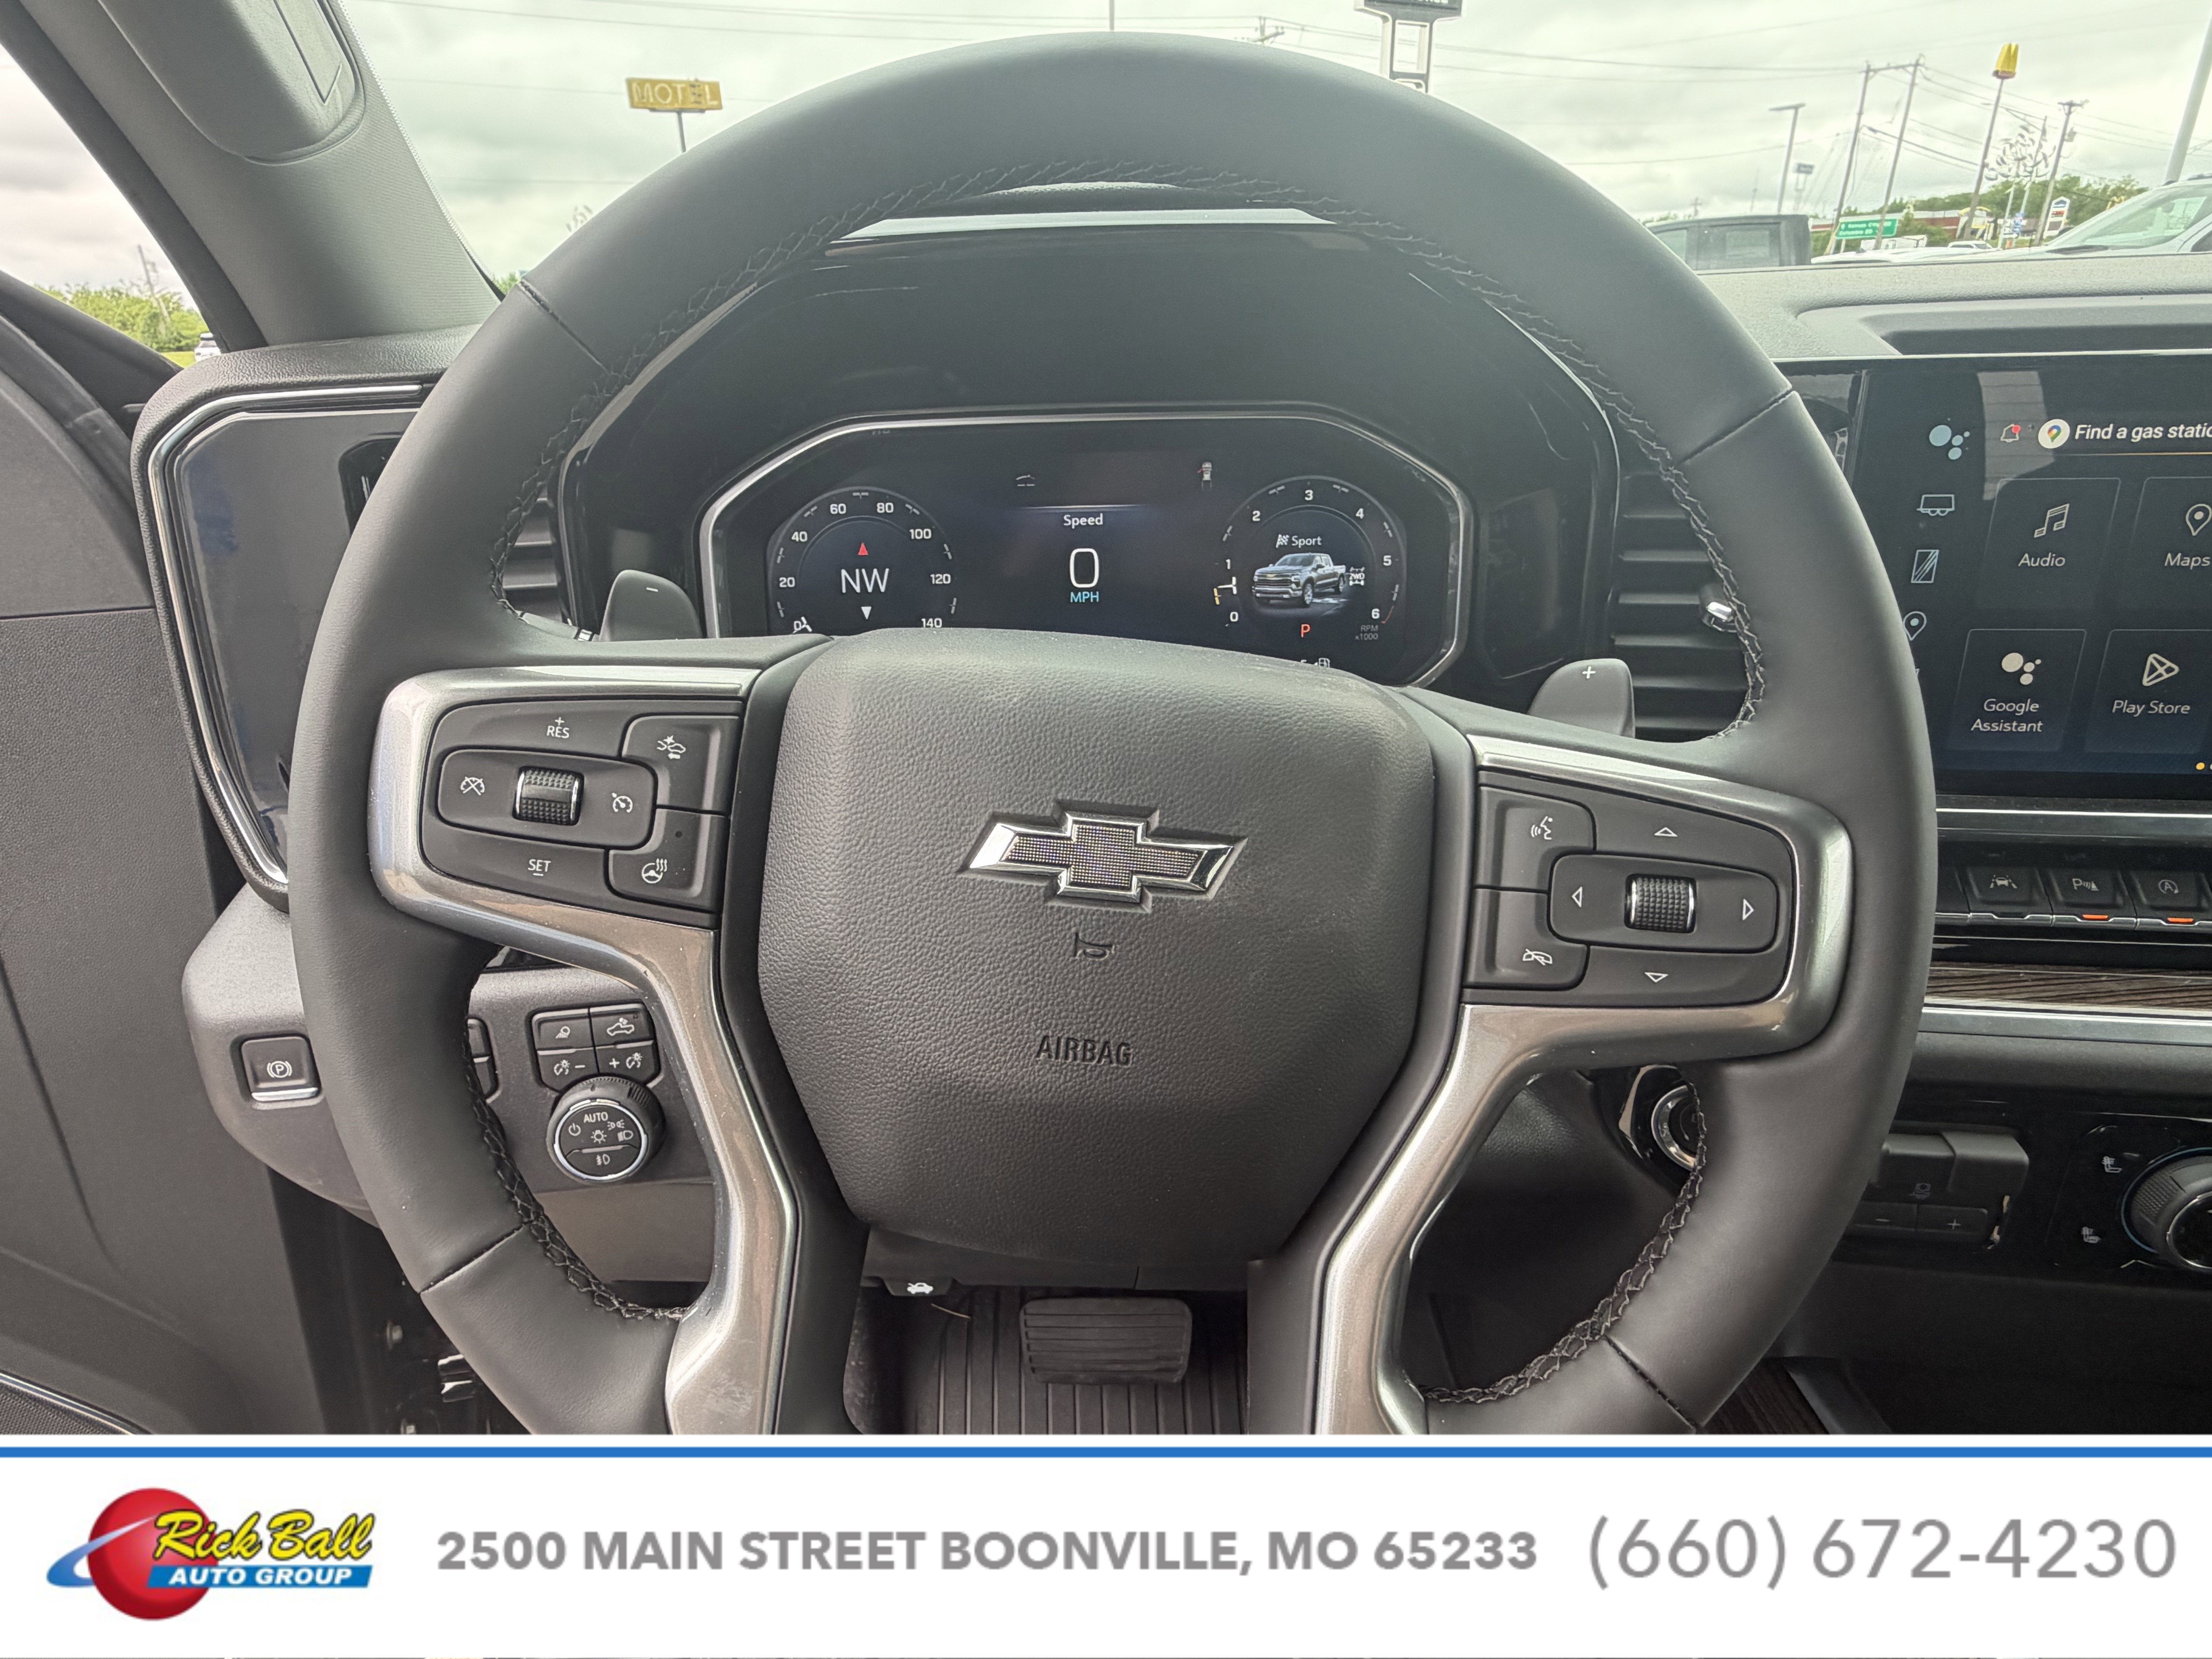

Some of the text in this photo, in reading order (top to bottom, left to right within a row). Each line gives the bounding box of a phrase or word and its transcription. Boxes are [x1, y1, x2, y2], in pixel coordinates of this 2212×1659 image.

[632, 83, 718, 104] MOTEL
[2075, 424, 2113, 440] Find
[2116, 427, 2128, 439] a
[2131, 426, 2164, 442] gas
[1305, 489, 1313, 501] 3
[830, 503, 846, 514] 60
[877, 502, 894, 513] 80
[1355, 508, 1364, 519] 4
[1063, 513, 1103, 529] Speed
[1252, 510, 1261, 521] 2
[791, 531, 807, 542] 40
[909, 528, 932, 539] 100
[1291, 535, 1322, 548] Sport
[1226, 559, 1231, 569] 1
[1383, 555, 1392, 566] 5
[2018, 552, 2065, 567] Audio
[2164, 553, 2210, 570] Maps
[1070, 548, 1099, 588] 0
[779, 577, 795, 587] 20
[841, 568, 889, 593] NW
[930, 574, 951, 584] 120
[1070, 591, 1099, 603] MPH
[1230, 611, 1238, 622] 0
[1372, 608, 1380, 619] 6
[921, 618, 943, 629] 140
[1301, 624, 1310, 637] P
[1984, 699, 2039, 716] Google
[2112, 700, 2190, 717] Play Store
[1971, 718, 2043, 732] Assistant
[546, 725, 570, 738] RES
[527, 859, 551, 872] SET
[1035, 1034, 1133, 1066] AIRBAG
[583, 1112, 608, 1123] AUTO
